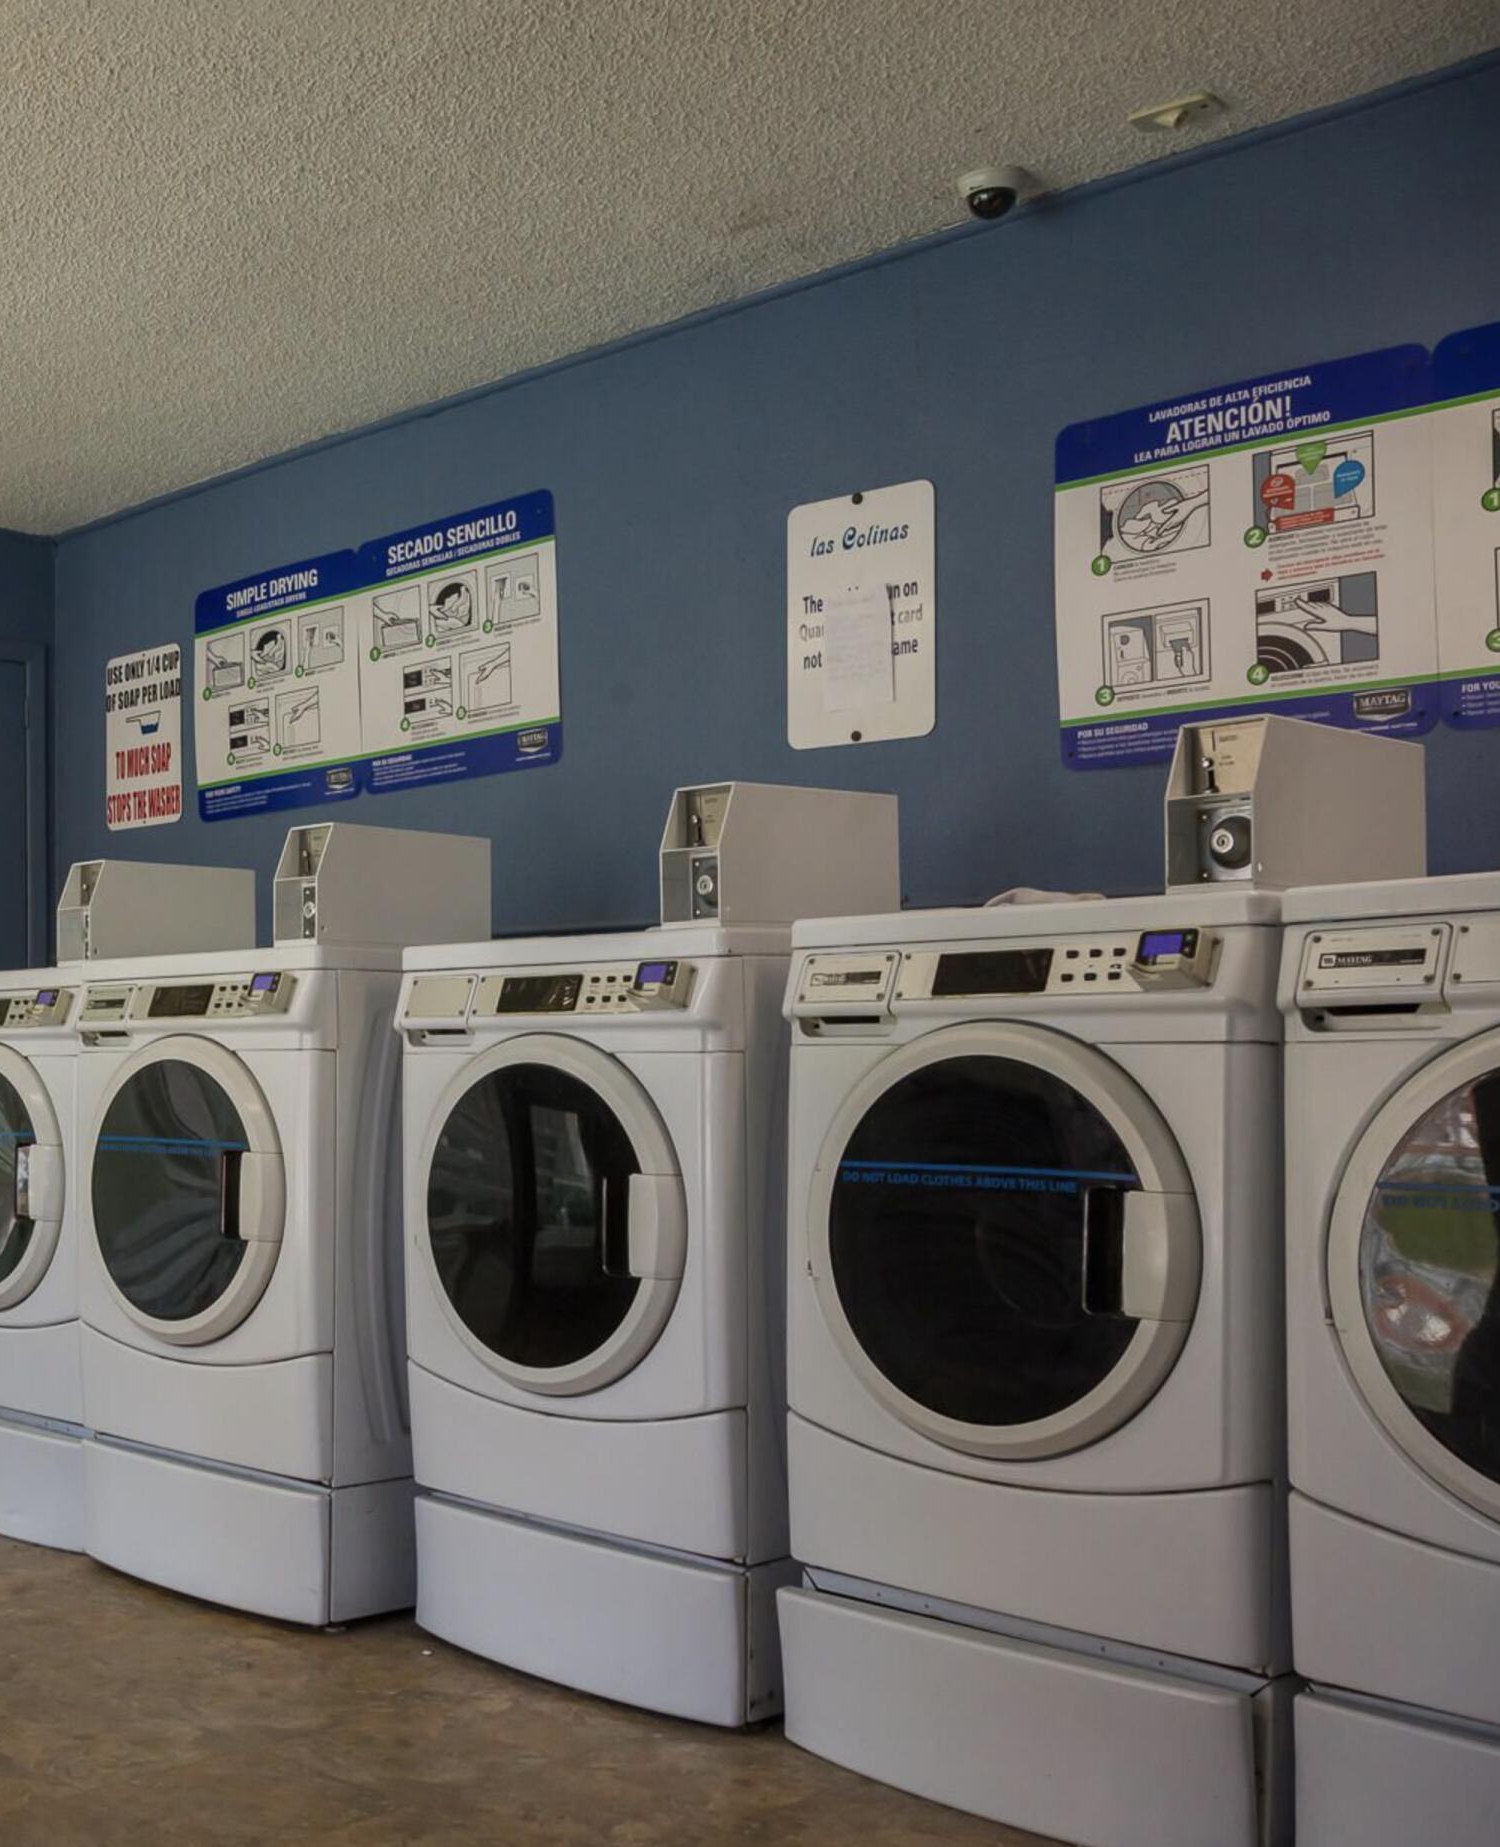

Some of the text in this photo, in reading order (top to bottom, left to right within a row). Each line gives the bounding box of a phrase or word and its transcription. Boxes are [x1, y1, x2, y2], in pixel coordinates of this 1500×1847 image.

[1149, 375, 1311, 423] LAVADORAS DE ALTA EFICIENCIA
[1166, 395, 1291, 445] ATENCIÓN!
[1134, 449, 1153, 464] LEA
[1154, 444, 1180, 459] PARA
[1182, 434, 1222, 452] LOGRAR
[1224, 430, 1240, 442] UN
[1242, 420, 1284, 439] LAVADO
[387, 510, 517, 565] SECADO SENCILLO
[226, 568, 318, 611] SIMPLE DRYING
[803, 595, 824, 615] The
[903, 581, 918, 597] on
[898, 603, 924, 623] card
[107, 651, 179, 686] USE ONLY 1/4 CUP
[803, 651, 823, 670] not
[106, 678, 181, 713] OF SOAP PER LOAD
[1360, 692, 1405, 708] MAYTAG
[1482, 680, 1500, 692] YOU
[116, 742, 172, 780] TO MUCH SOAP
[107, 794, 131, 825] STOPS
[133, 790, 147, 820] THE
[148, 784, 181, 818] WASHER
[842, 1171, 1077, 1193] DO NOT LOAD CLOTHES ABOVE THIS LINE
